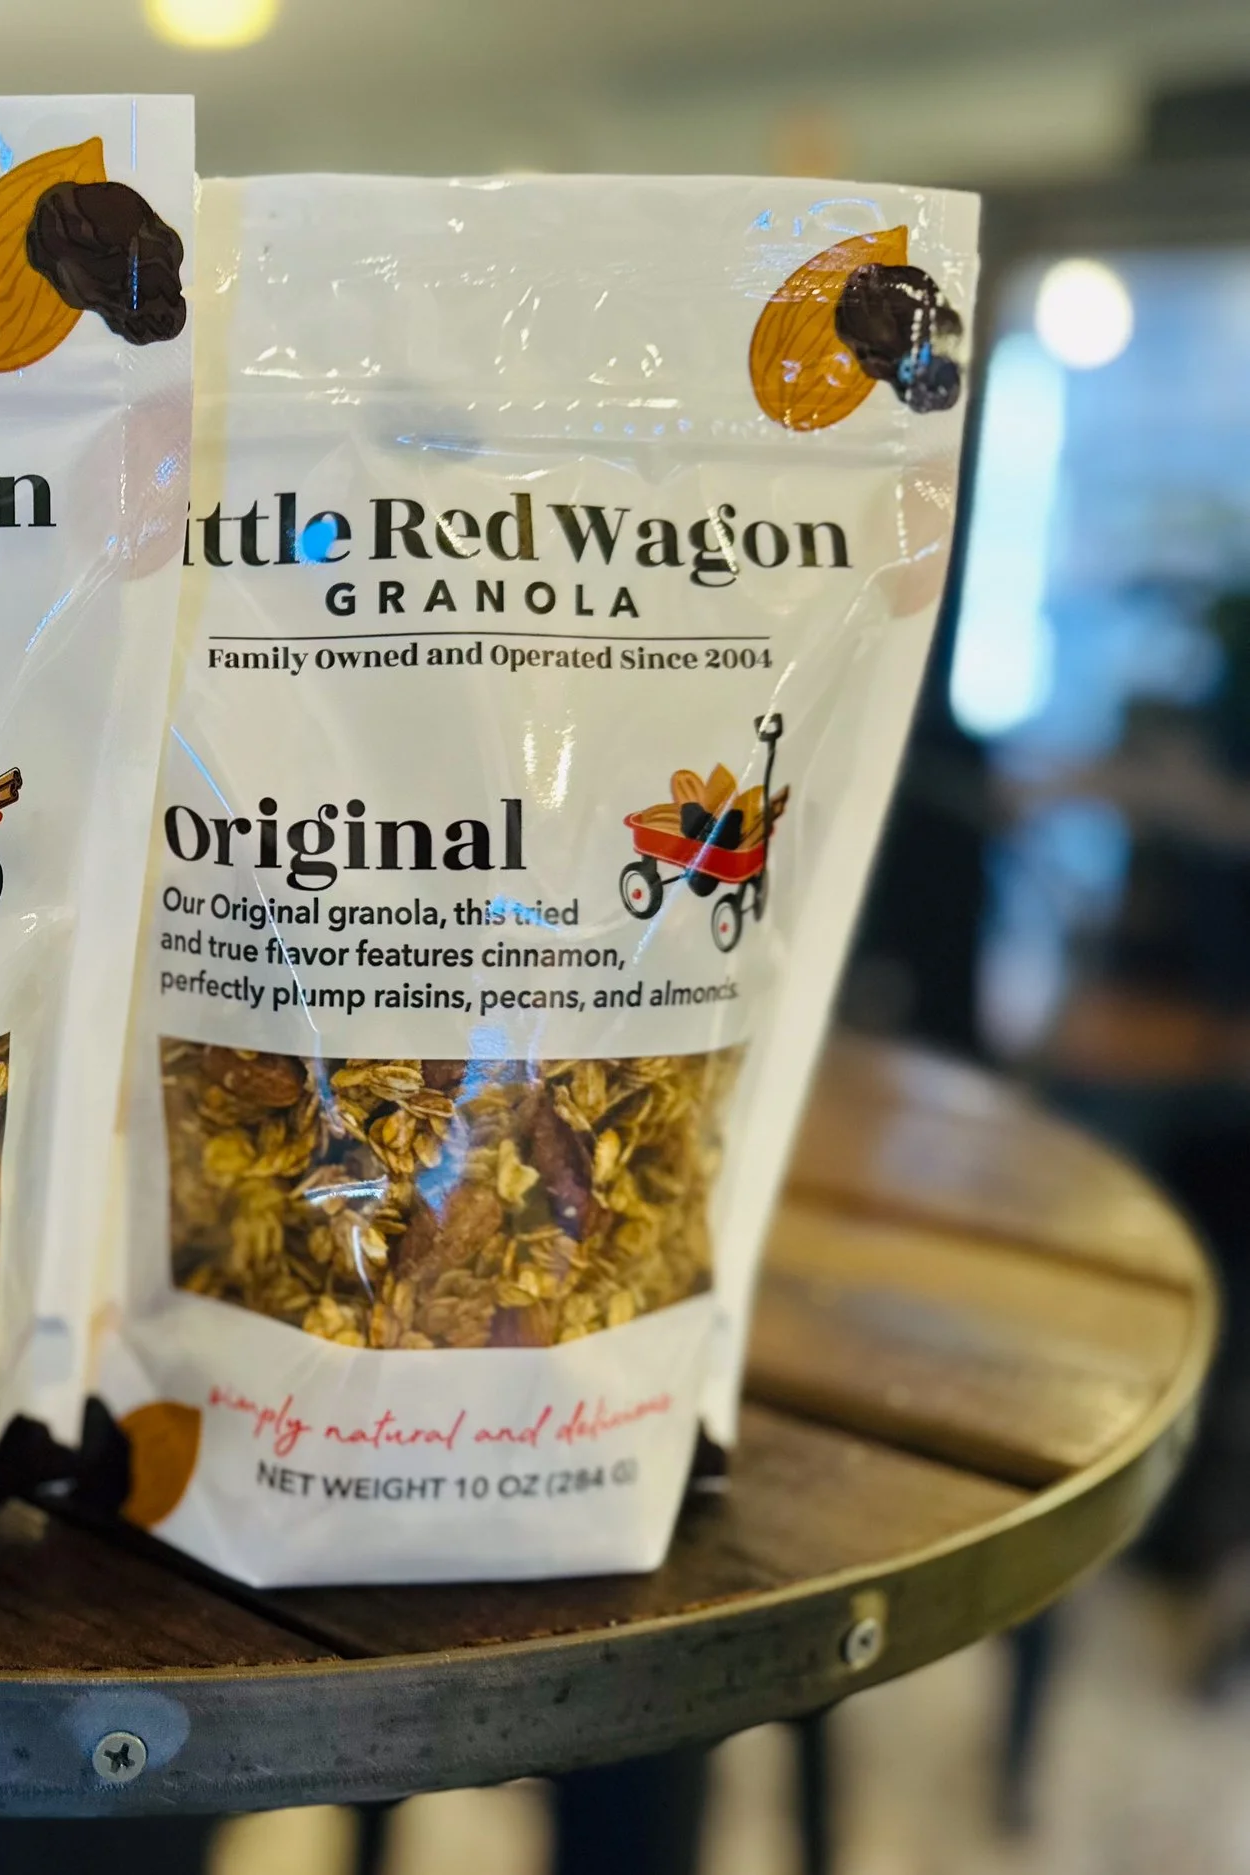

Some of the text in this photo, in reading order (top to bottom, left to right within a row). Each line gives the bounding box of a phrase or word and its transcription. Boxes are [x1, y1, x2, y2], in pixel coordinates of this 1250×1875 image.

[182, 491, 853, 588] ttle Red Wagon
[325, 578, 640, 618] GRANOLA
[207, 640, 773, 676] Family Owned and Operated Since 2004
[164, 796, 528, 892] Original
[162, 885, 580, 932] Our Original granola, this tried
[160, 929, 626, 971] and true flavor features cinnamon,
[160, 969, 265, 1009] perfectly
[272, 978, 366, 1016] plump
[373, 982, 473, 1012] raisins,
[479, 985, 586, 1016] pecans,
[593, 980, 643, 1008] and
[324, 1409, 467, 1451] natural
[474, 1404, 554, 1450] and
[256, 1458, 317, 1498] NET
[322, 1476, 448, 1502] WEIGHT
[455, 1476, 491, 1500] 10
[497, 1472, 540, 1499] OZ
